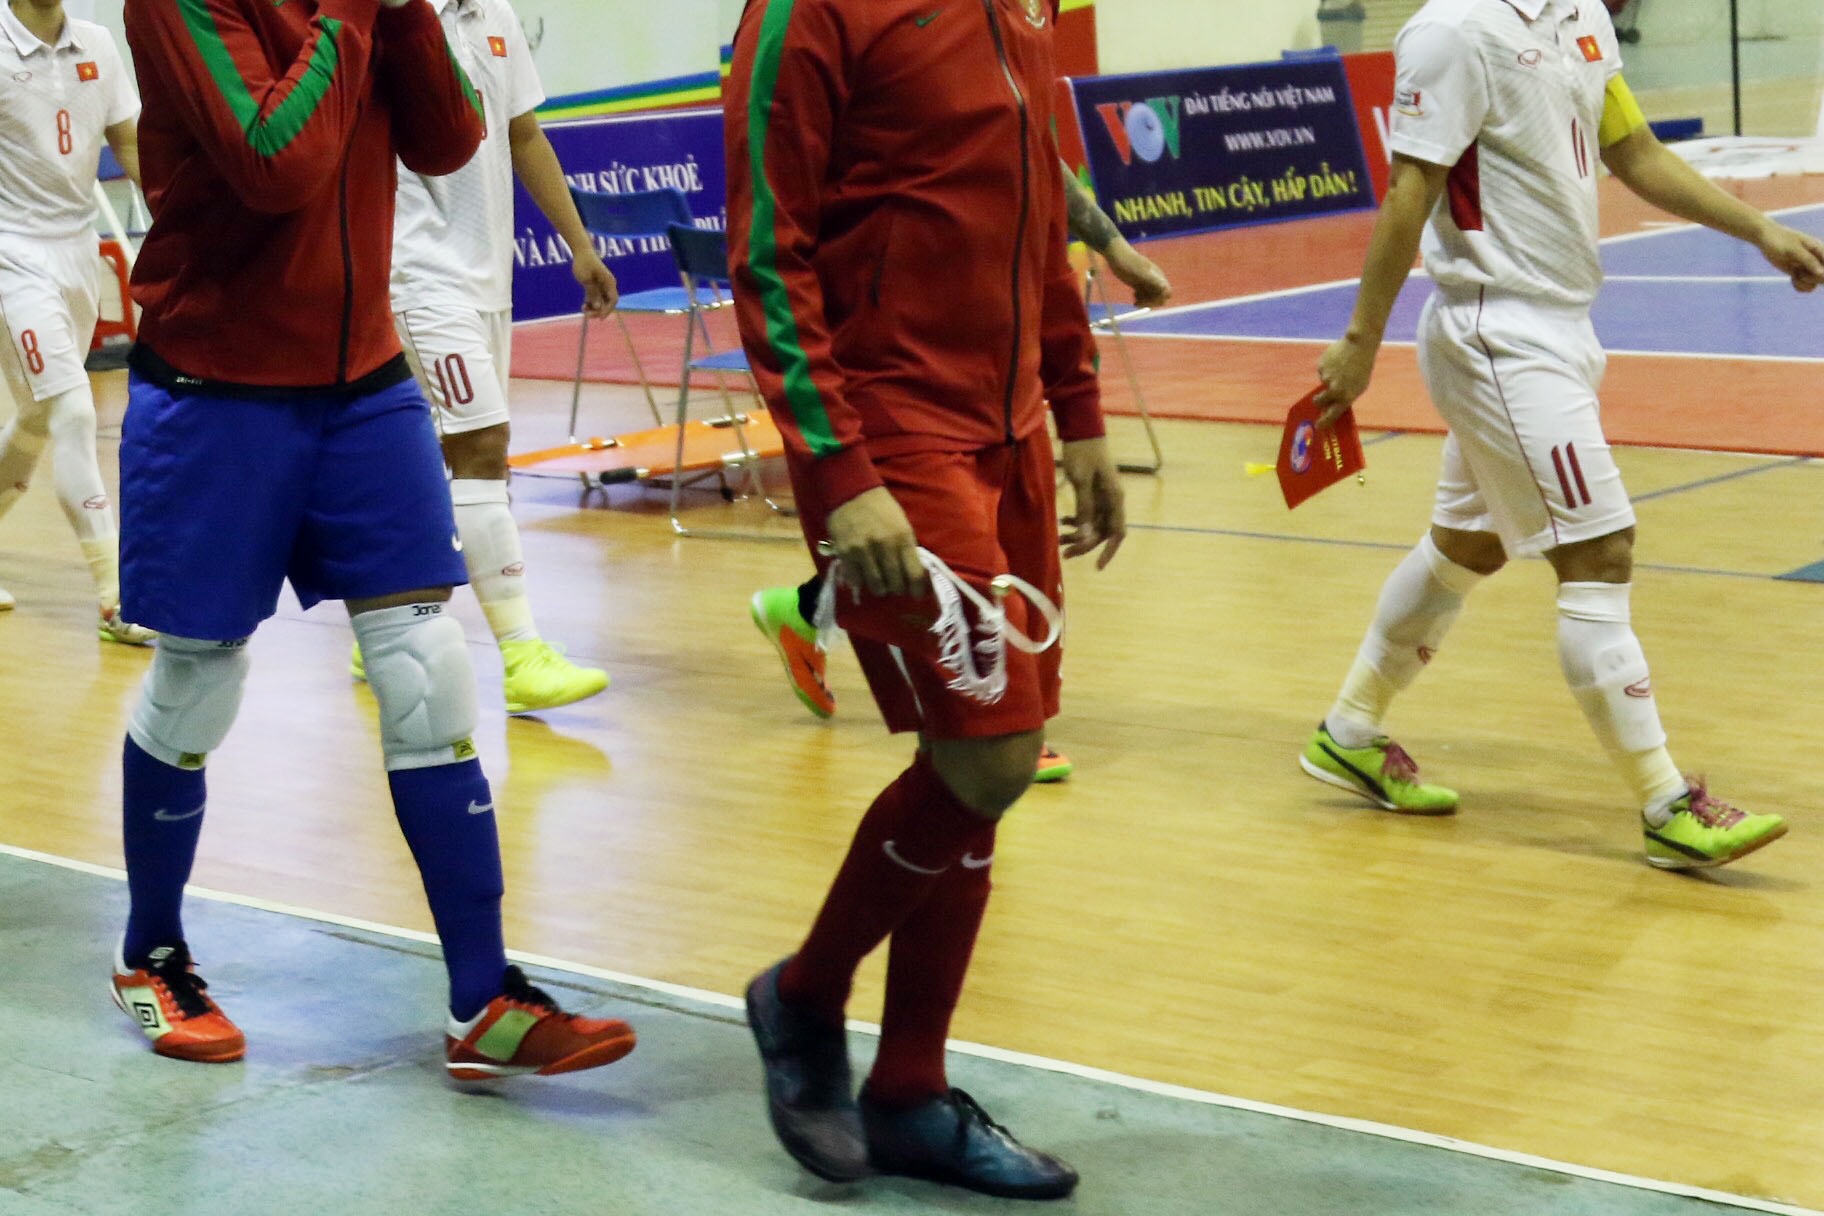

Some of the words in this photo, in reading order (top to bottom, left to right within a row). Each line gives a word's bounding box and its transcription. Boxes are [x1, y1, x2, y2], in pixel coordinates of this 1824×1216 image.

[1210, 86, 1251, 112] TIẾNG
[1277, 84, 1304, 109] VIỆT
[1304, 86, 1336, 104] NAM
[57, 109, 72, 155] 8
[1095, 96, 1181, 166] VOV
[1224, 126, 1315, 152] WWW.VOV.VN
[1570, 116, 1588, 179] 11
[1113, 192, 1193, 223] NHANH,
[1193, 187, 1227, 212] TIN
[1228, 175, 1270, 212] CẬY,
[1272, 166, 1306, 202] HẤP
[20, 327, 46, 375] 8
[434, 352, 475, 409] 10
[1551, 440, 1592, 510] 11
